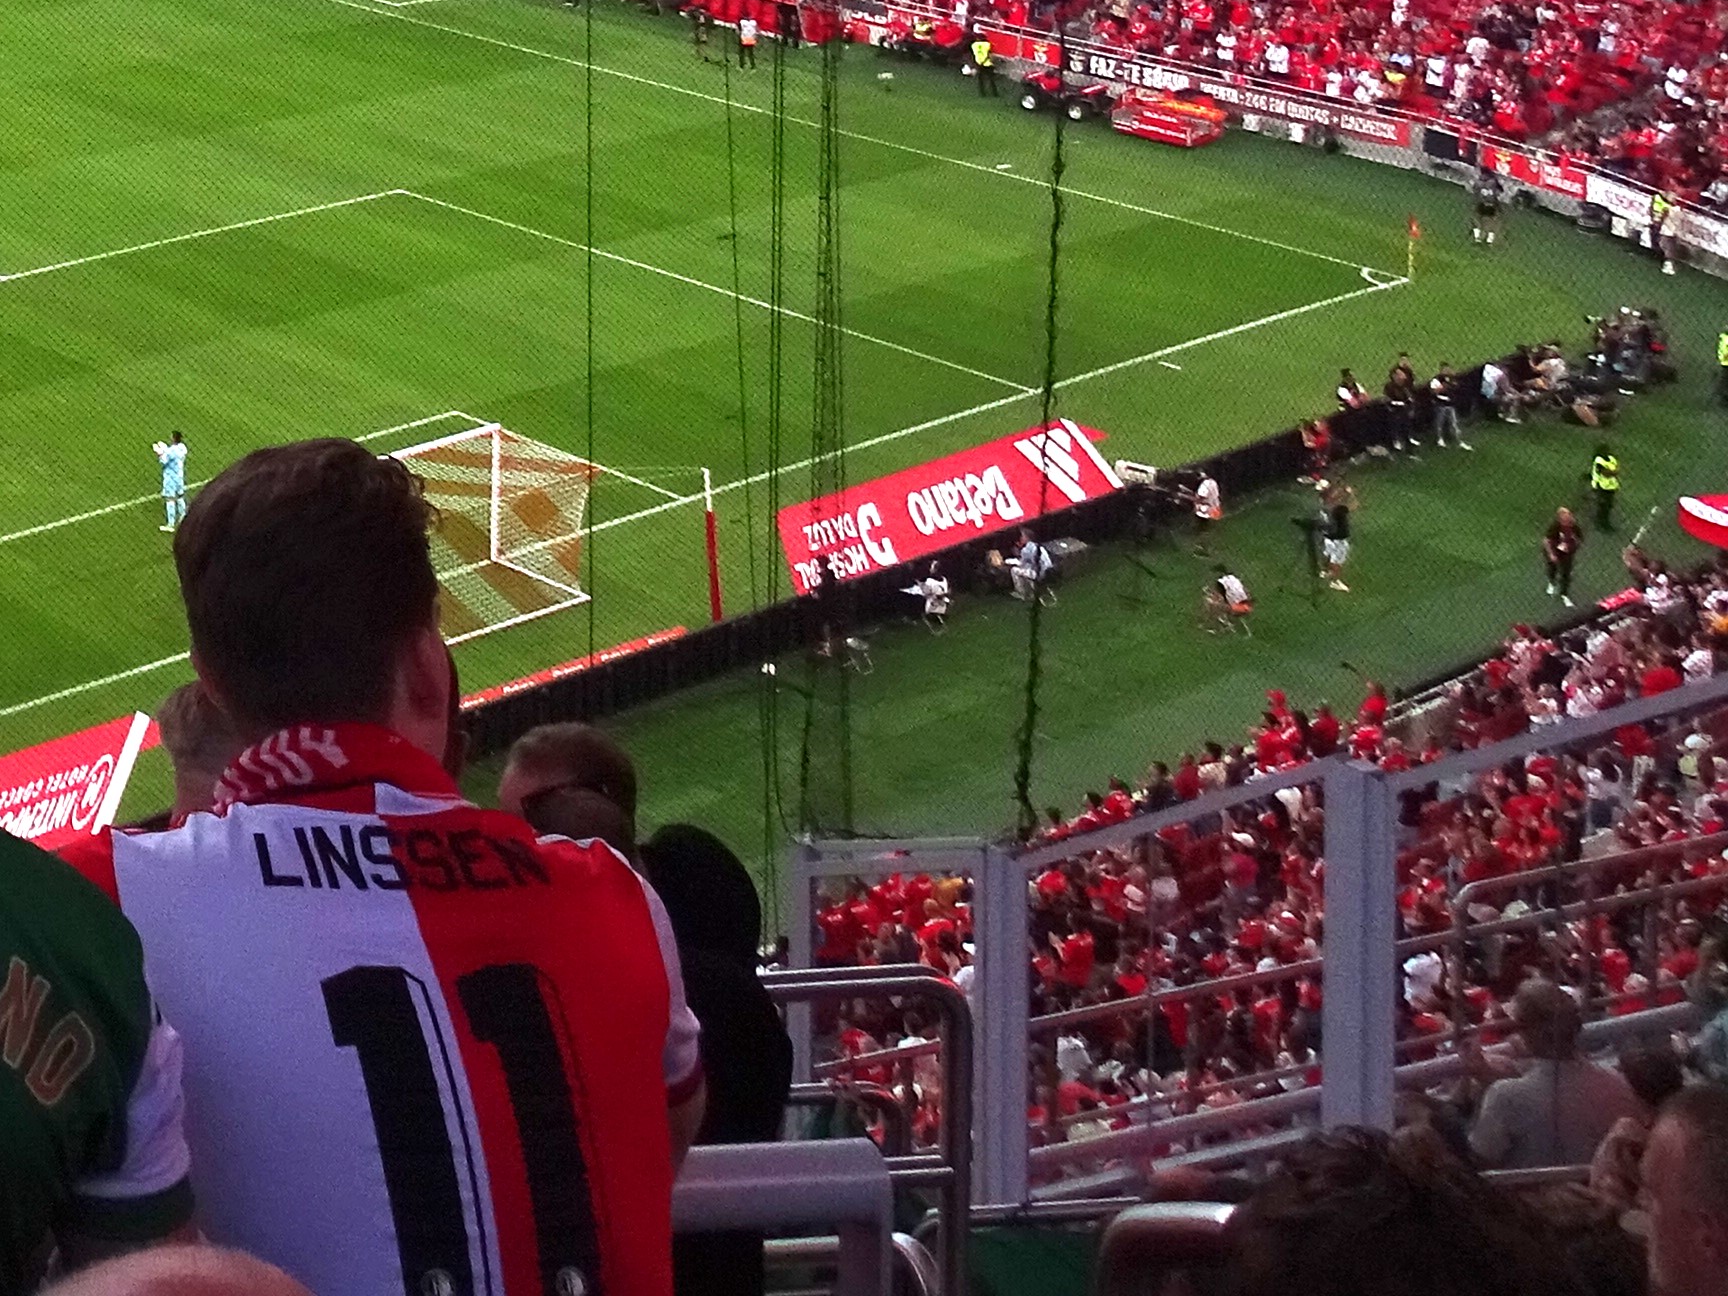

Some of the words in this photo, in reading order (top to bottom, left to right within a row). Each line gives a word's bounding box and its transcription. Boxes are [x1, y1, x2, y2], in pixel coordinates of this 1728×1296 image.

[906, 464, 1024, 536] Betano
[44, 763, 89, 795] HOTEL
[252, 822, 551, 892] LINSSEN
[320, 962, 606, 1296] 11
